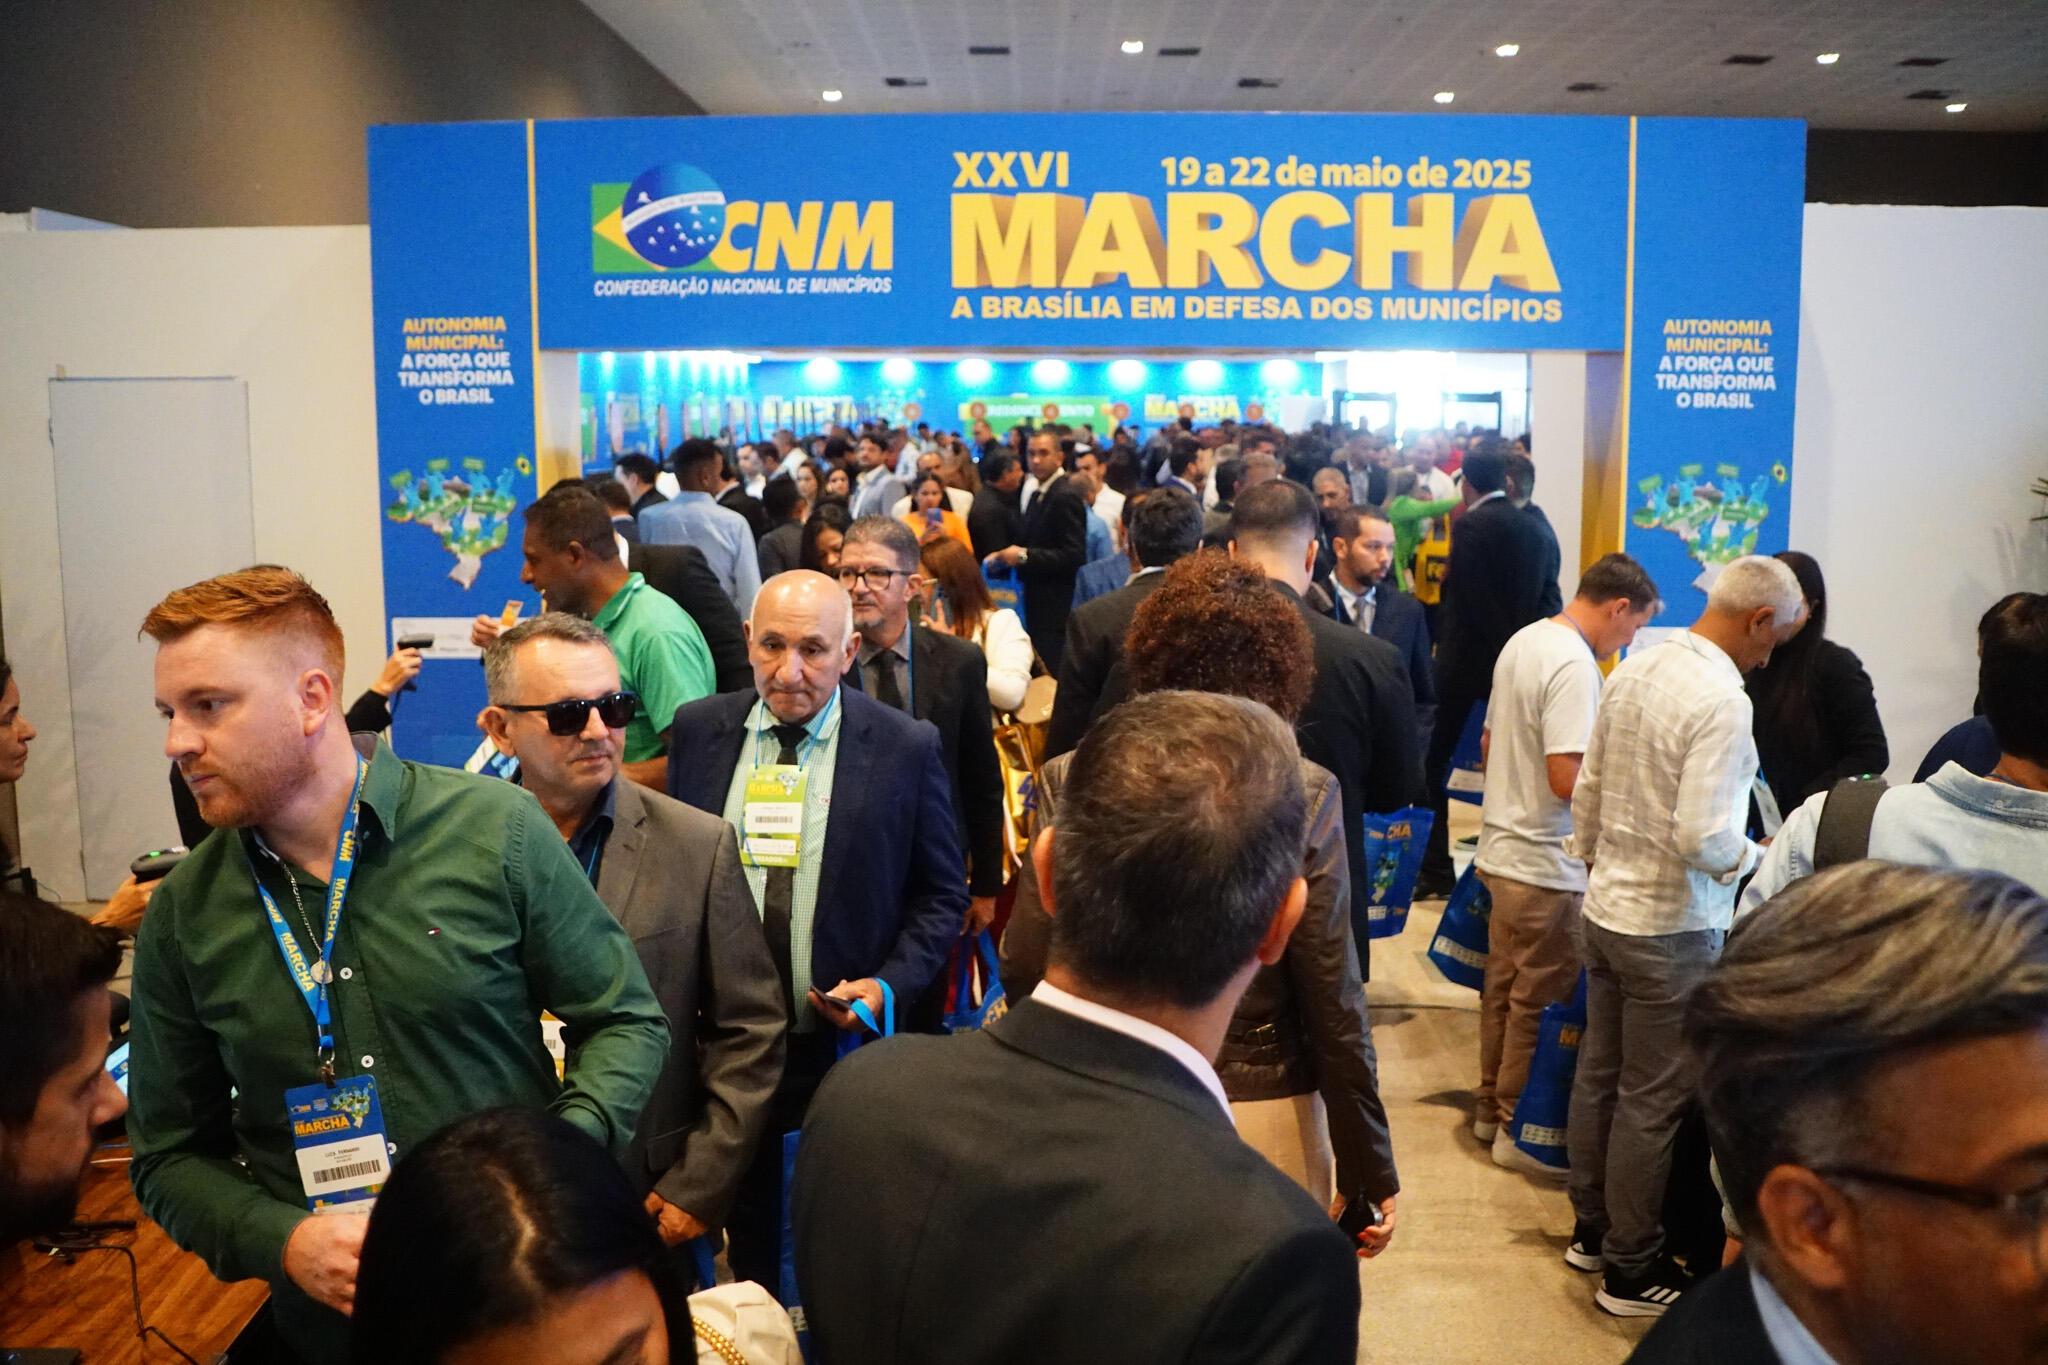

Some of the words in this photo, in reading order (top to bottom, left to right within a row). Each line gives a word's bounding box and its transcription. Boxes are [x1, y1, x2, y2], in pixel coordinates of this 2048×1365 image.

[952, 151, 1069, 188] XXVI
[1161, 157, 1201, 186] 19
[1204, 163, 1225, 187] a
[1230, 157, 1270, 187] 22
[1275, 155, 1317, 187] de
[1321, 156, 1403, 188] maio
[1407, 156, 1449, 188] de
[1452, 159, 1532, 189] 2025
[709, 200, 894, 273] CNM
[951, 190, 1562, 292] MARCHA
[594, 276, 708, 298] CONFEDERAÇÃO
[711, 278, 783, 295] NACIONAL
[786, 278, 807, 294] DE
[809, 274, 893, 294] MUNICÍPIOS
[951, 296, 974, 319] A
[981, 291, 1123, 319] BRASÍLIA
[1131, 296, 1176, 319] EM
[1184, 296, 1303, 320] DEFESA
[1310, 297, 1373, 321] DOS
[1382, 293, 1563, 323] MUNICÍPIOS
[402, 316, 507, 333] AUTONOMIA
[1663, 319, 1773, 335] AUTONOMIA
[406, 334, 504, 351] MUNICIPAL:
[1665, 337, 1769, 354] MUNICIPAL:
[401, 354, 414, 369] A
[415, 353, 473, 372] FORÇA
[474, 352, 511, 369] QUE
[1659, 356, 1673, 371] A
[1675, 356, 1735, 375] FORÇA
[1737, 356, 1774, 373] QUE
[398, 369, 514, 387] TRANSFORMA
[1655, 373, 1776, 391] TRANSFORMA
[418, 388, 434, 405] O
[435, 388, 494, 404] BRASIL
[1676, 391, 1691, 408] O
[1693, 392, 1754, 409] BRASIL
[1145, 398, 1240, 421] MACHA
[325, 878, 346, 942] MARCHA
[281, 932, 317, 992] MARCHA
[294, 1115, 351, 1136] MARCHA
